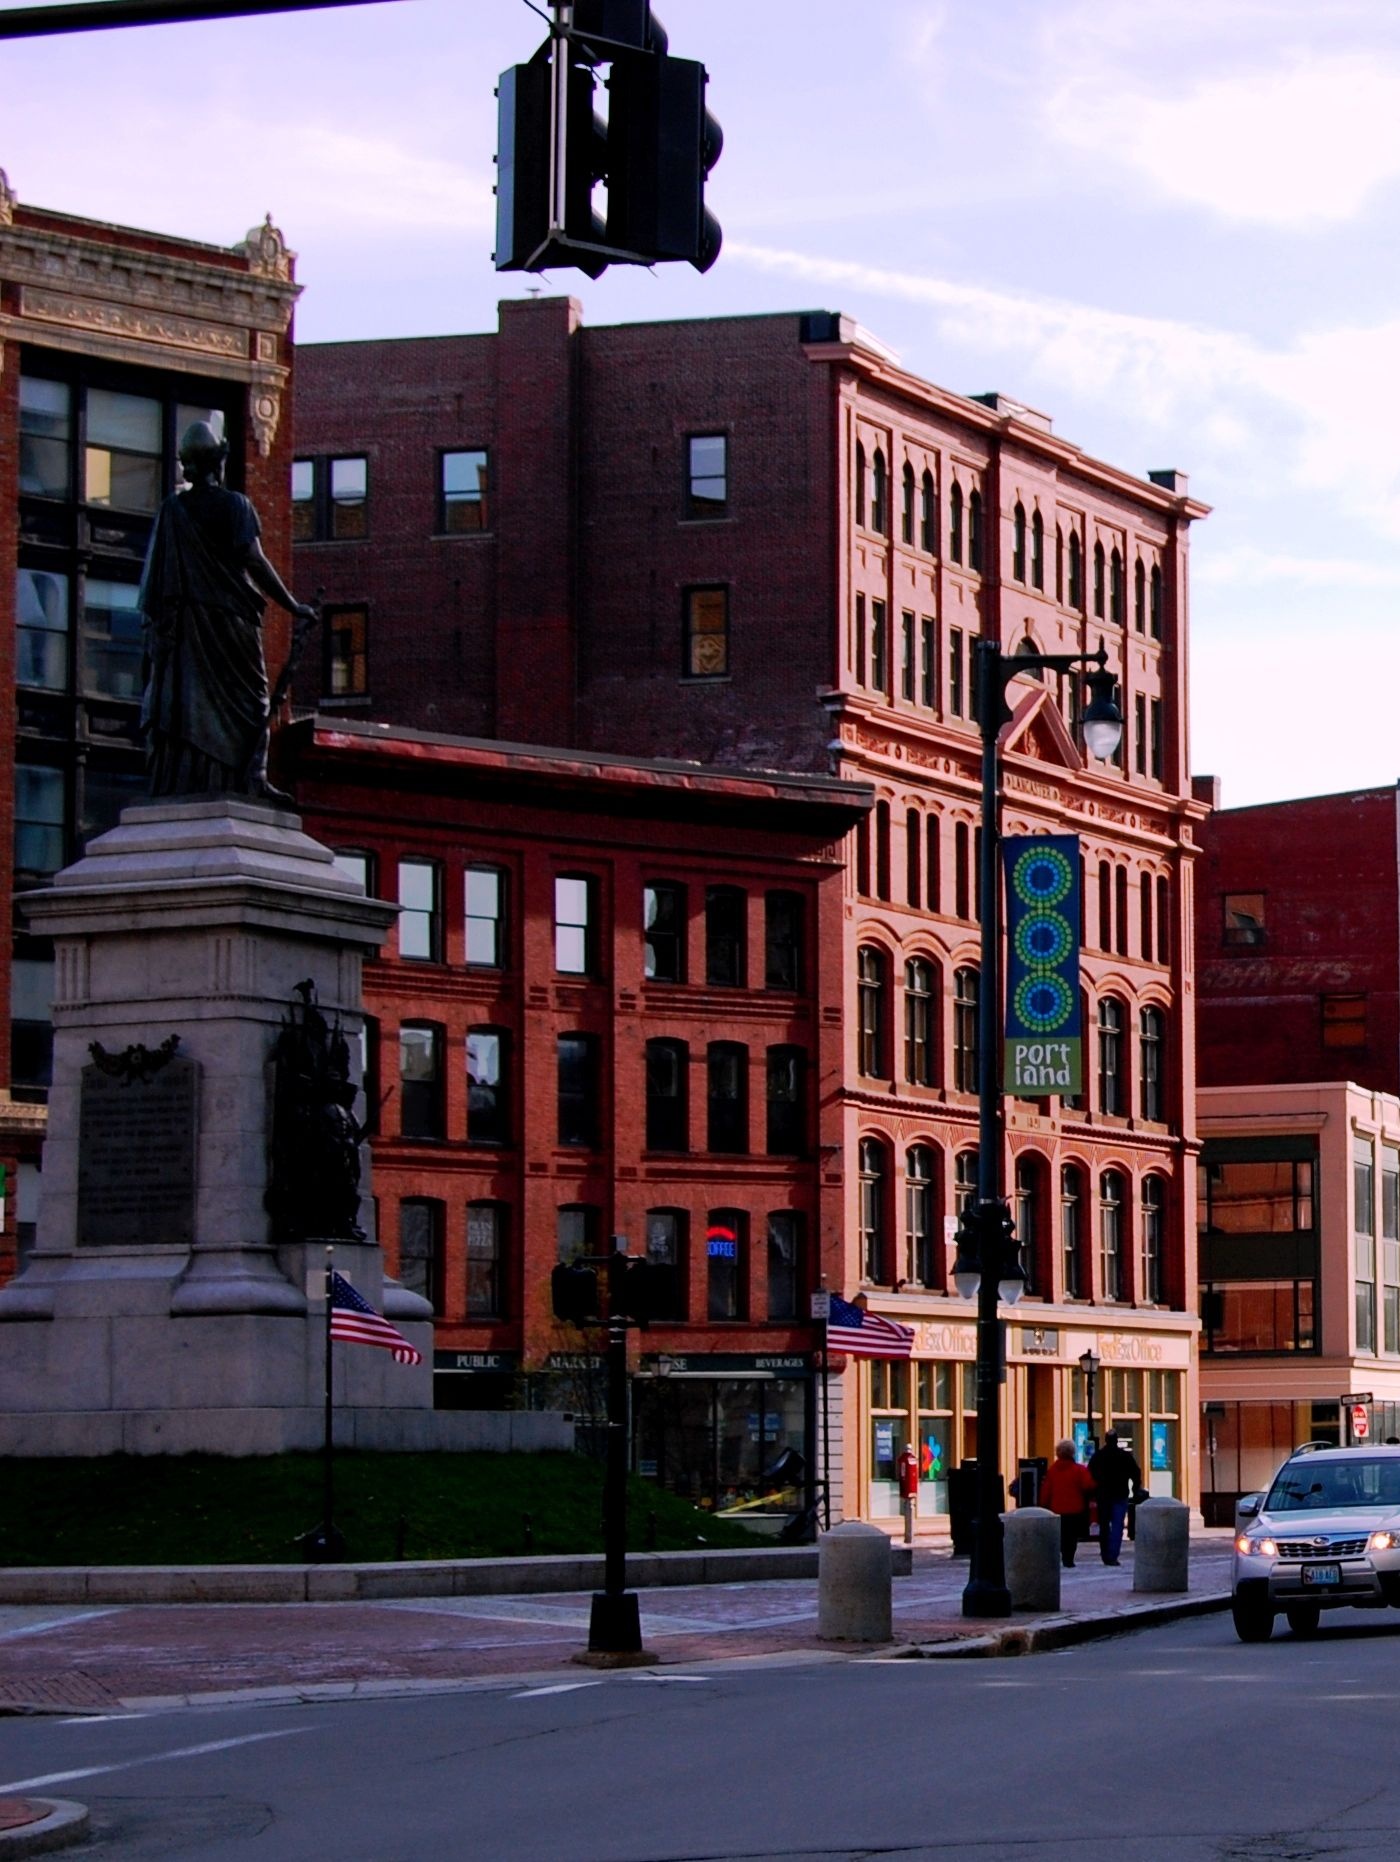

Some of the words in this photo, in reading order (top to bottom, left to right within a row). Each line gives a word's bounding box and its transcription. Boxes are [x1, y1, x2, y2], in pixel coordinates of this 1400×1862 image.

[706, 1241, 735, 1257] COFFEE
[456, 1355, 500, 1368] PUBLIC
[755, 1358, 804, 1368] BEVERAGES
